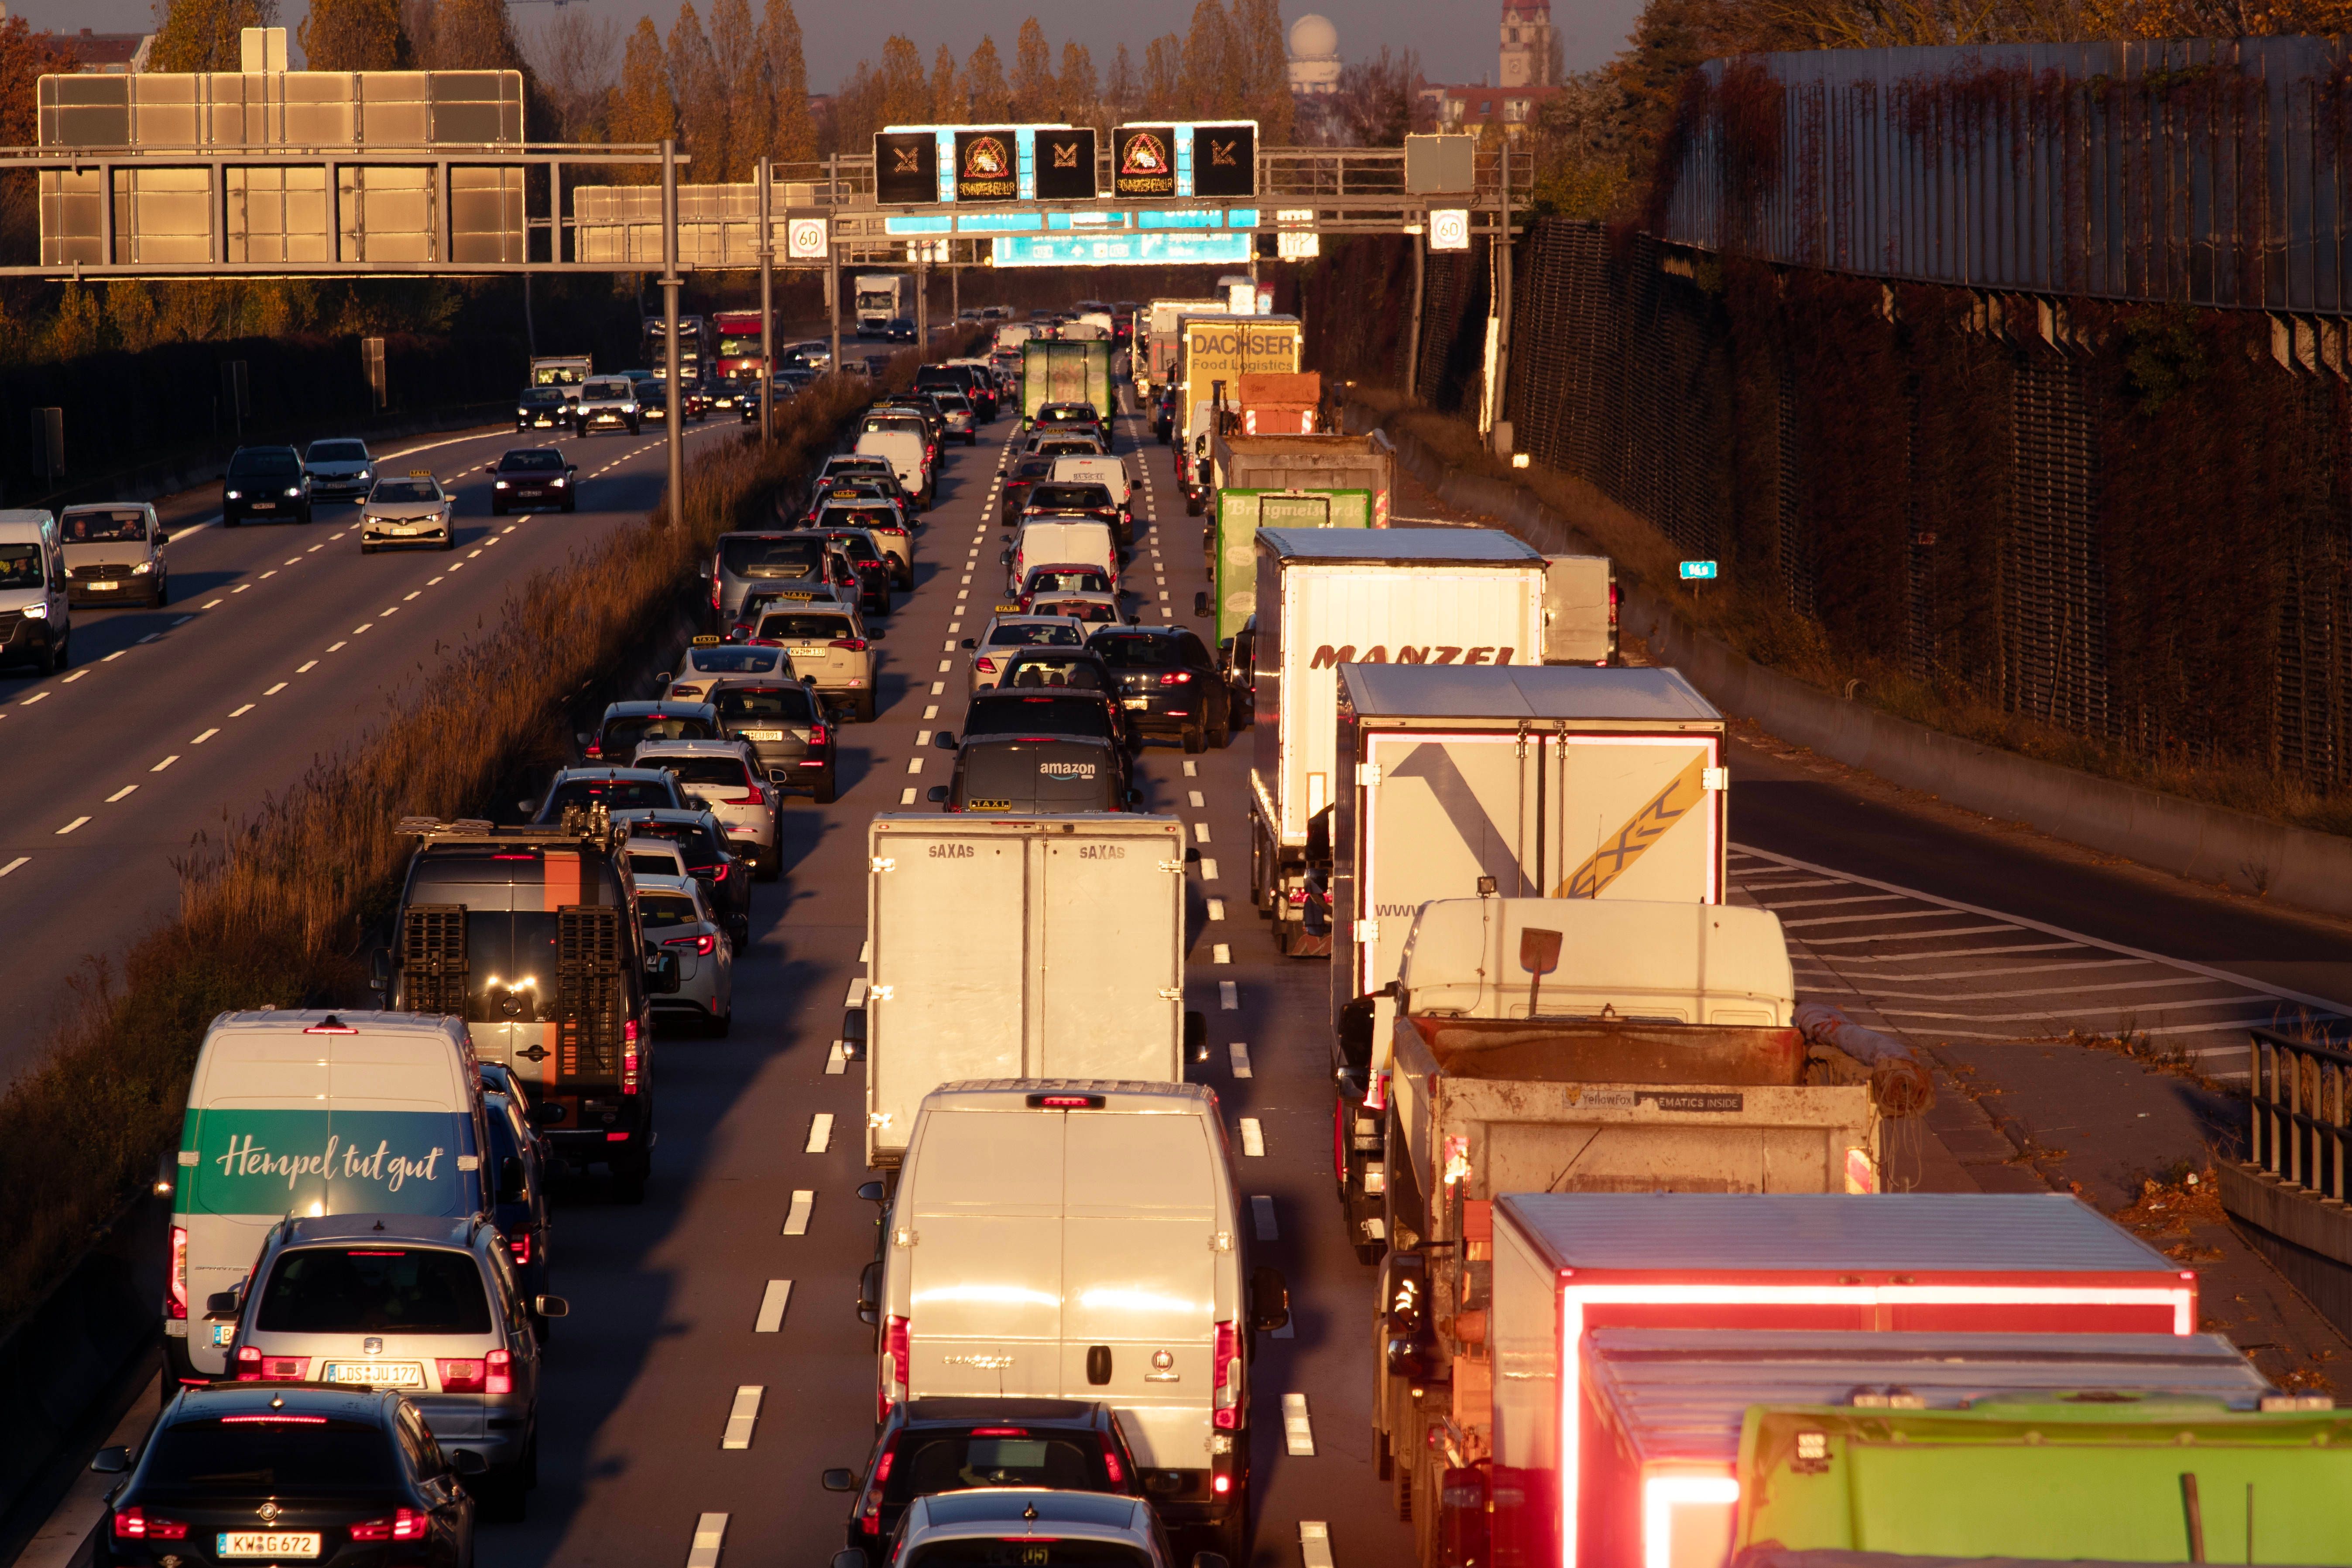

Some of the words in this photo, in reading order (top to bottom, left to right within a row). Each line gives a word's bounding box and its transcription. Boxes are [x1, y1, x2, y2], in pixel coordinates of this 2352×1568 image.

[1440, 222, 1458, 236] 60
[799, 231, 818, 246] 60
[1191, 334, 1293, 355] DACHSER
[1192, 359, 1227, 370] Food
[1231, 359, 1293, 372] Logistics
[1227, 499, 1362, 519] Bringmeister.de
[1040, 763, 1096, 774] amazon
[928, 844, 974, 859] SAXAS
[1079, 845, 1125, 859] SAXAS
[1582, 1094, 1631, 1105] YellowFox
[1707, 1098, 1738, 1109] INSIDE
[216, 1134, 340, 1191] Hempel
[342, 1140, 390, 1181] tut
[337, 1367, 362, 1381] LDS
[373, 1367, 389, 1381] JU
[392, 1367, 416, 1381] 177
[233, 1536, 255, 1551] KW
[267, 1536, 277, 1551] G
[281, 1537, 311, 1552] 672
